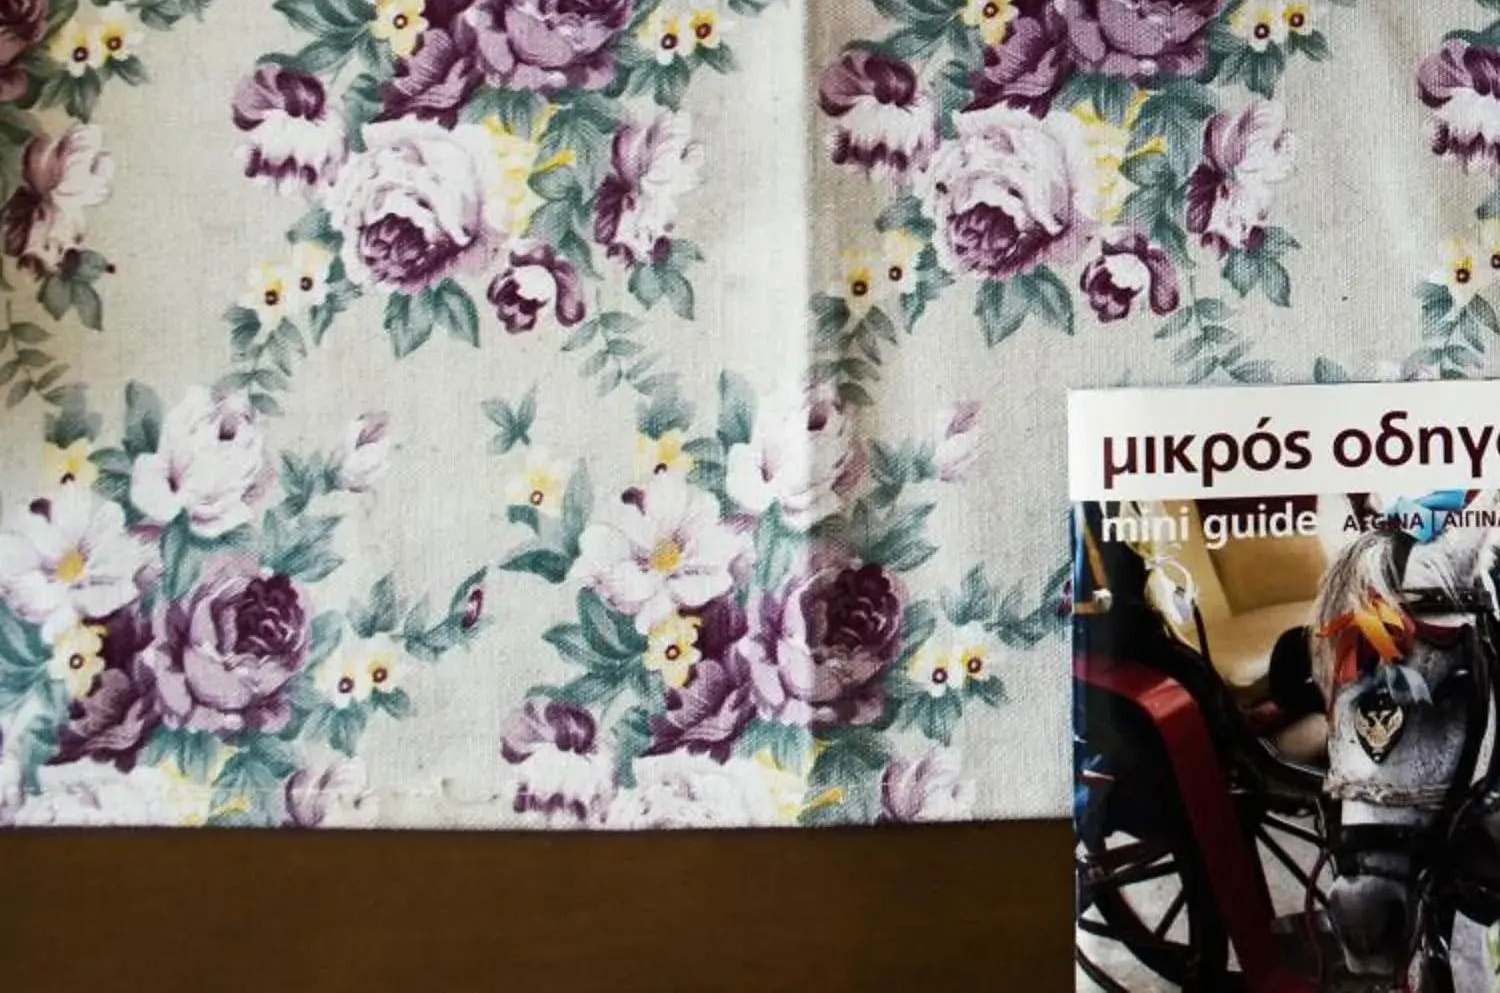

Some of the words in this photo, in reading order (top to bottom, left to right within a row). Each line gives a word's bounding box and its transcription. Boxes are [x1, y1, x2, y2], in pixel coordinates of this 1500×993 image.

[1103, 416, 1313, 489] μικρός
[1101, 506, 1189, 543] mini
[1203, 502, 1319, 550] guide
[1343, 512, 1426, 533] AEGINA
